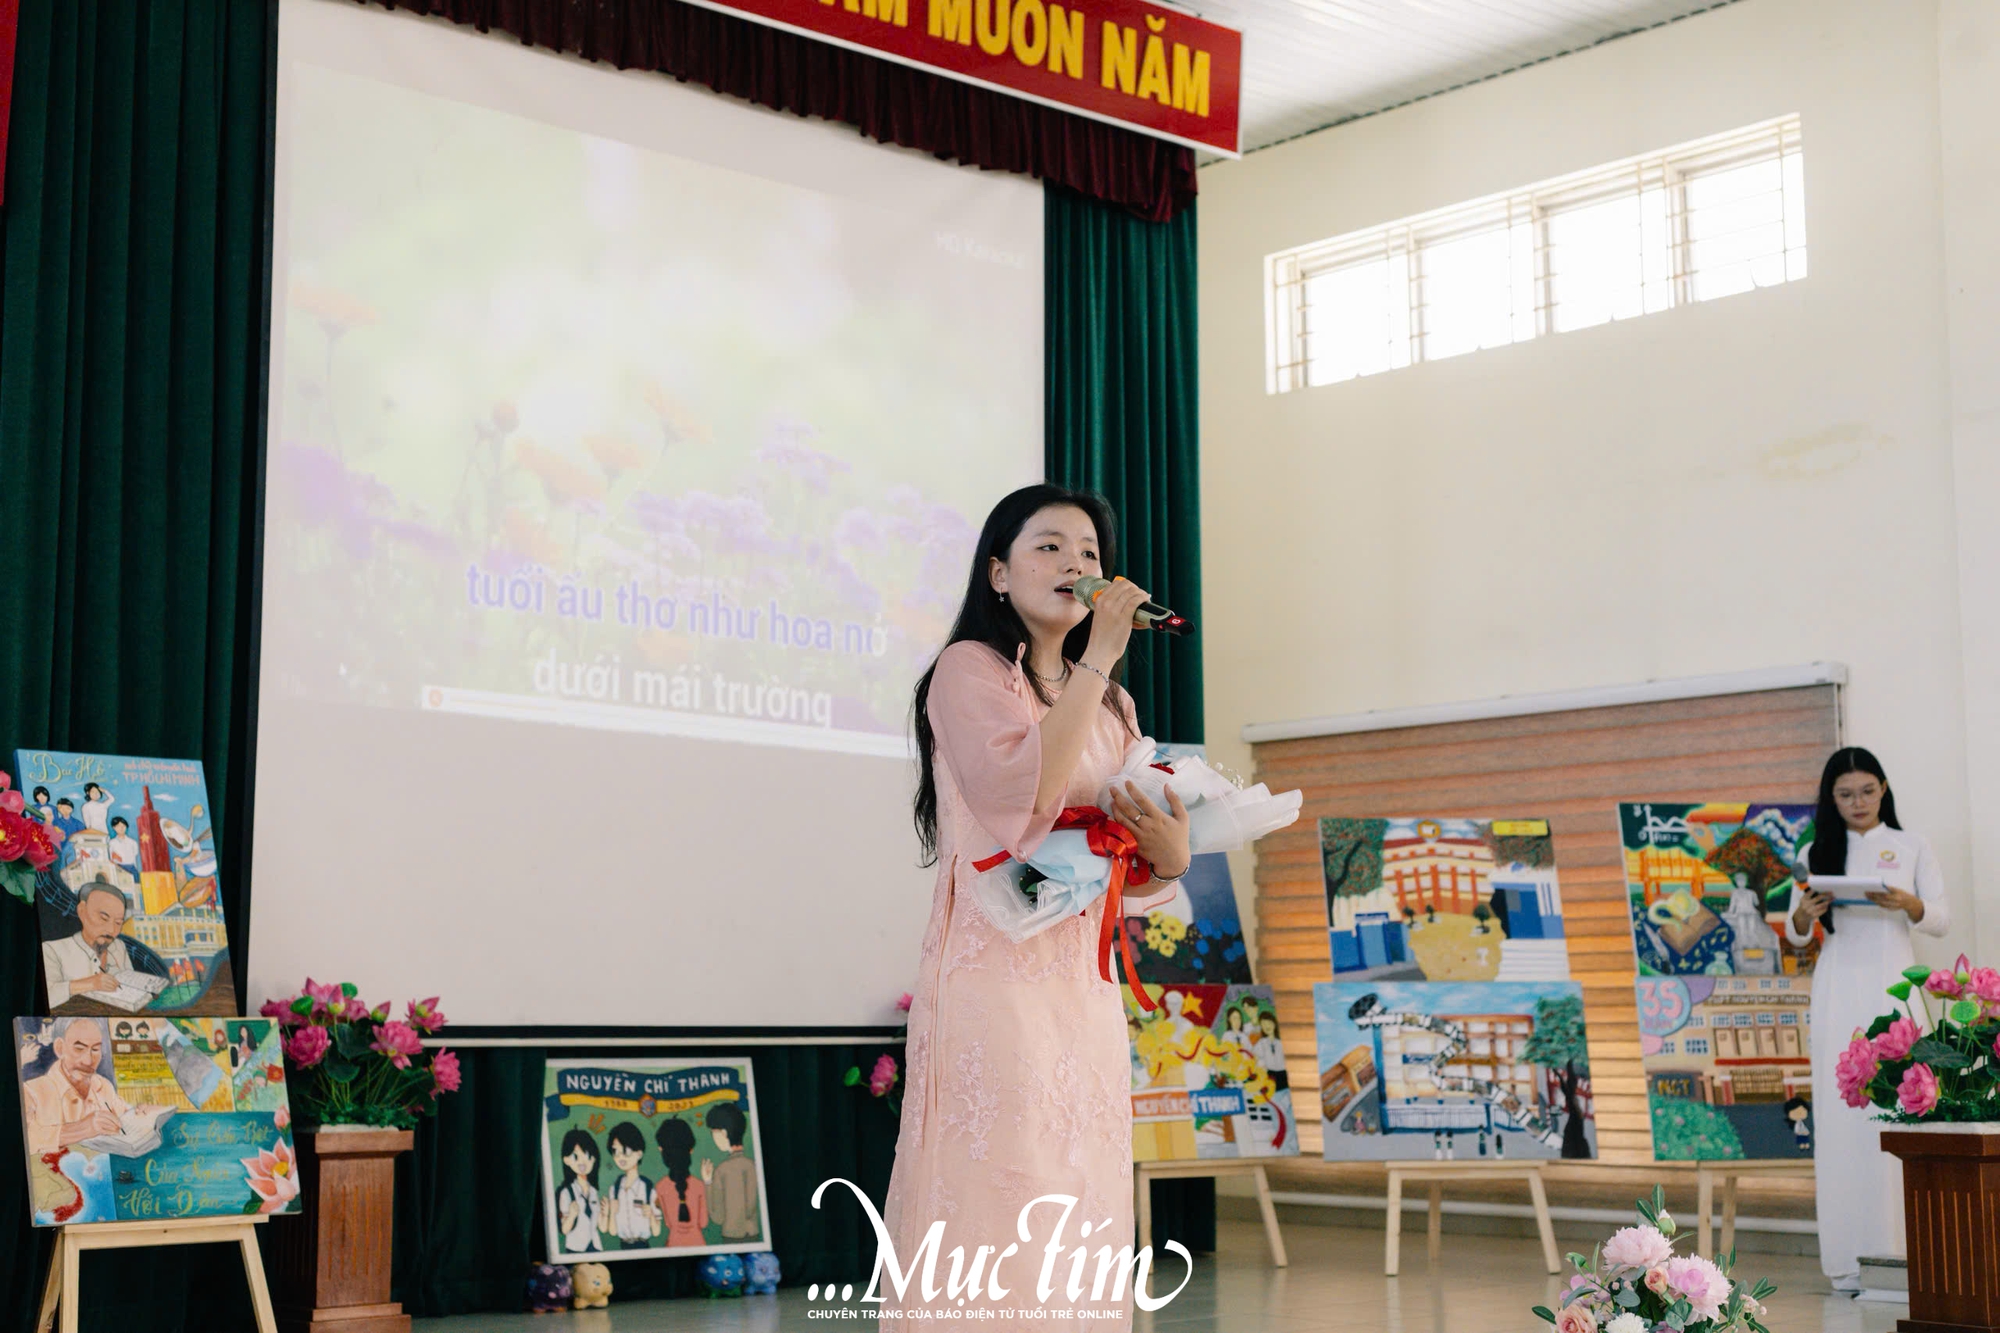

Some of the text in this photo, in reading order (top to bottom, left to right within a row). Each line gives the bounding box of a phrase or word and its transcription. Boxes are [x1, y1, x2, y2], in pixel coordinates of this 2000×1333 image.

[1102, 14, 1211, 118] NĂM
[466, 562, 544, 614] tuổi
[615, 580, 681, 631] thơ
[688, 591, 762, 642] như
[769, 600, 833, 651] hoa
[534, 647, 833, 729] dưới mái trường
[1638, 979, 1684, 1019] 35
[566, 1073, 730, 1093] NGUYỄN CHÍ THANH
[1657, 1078, 1691, 1096] NCT
